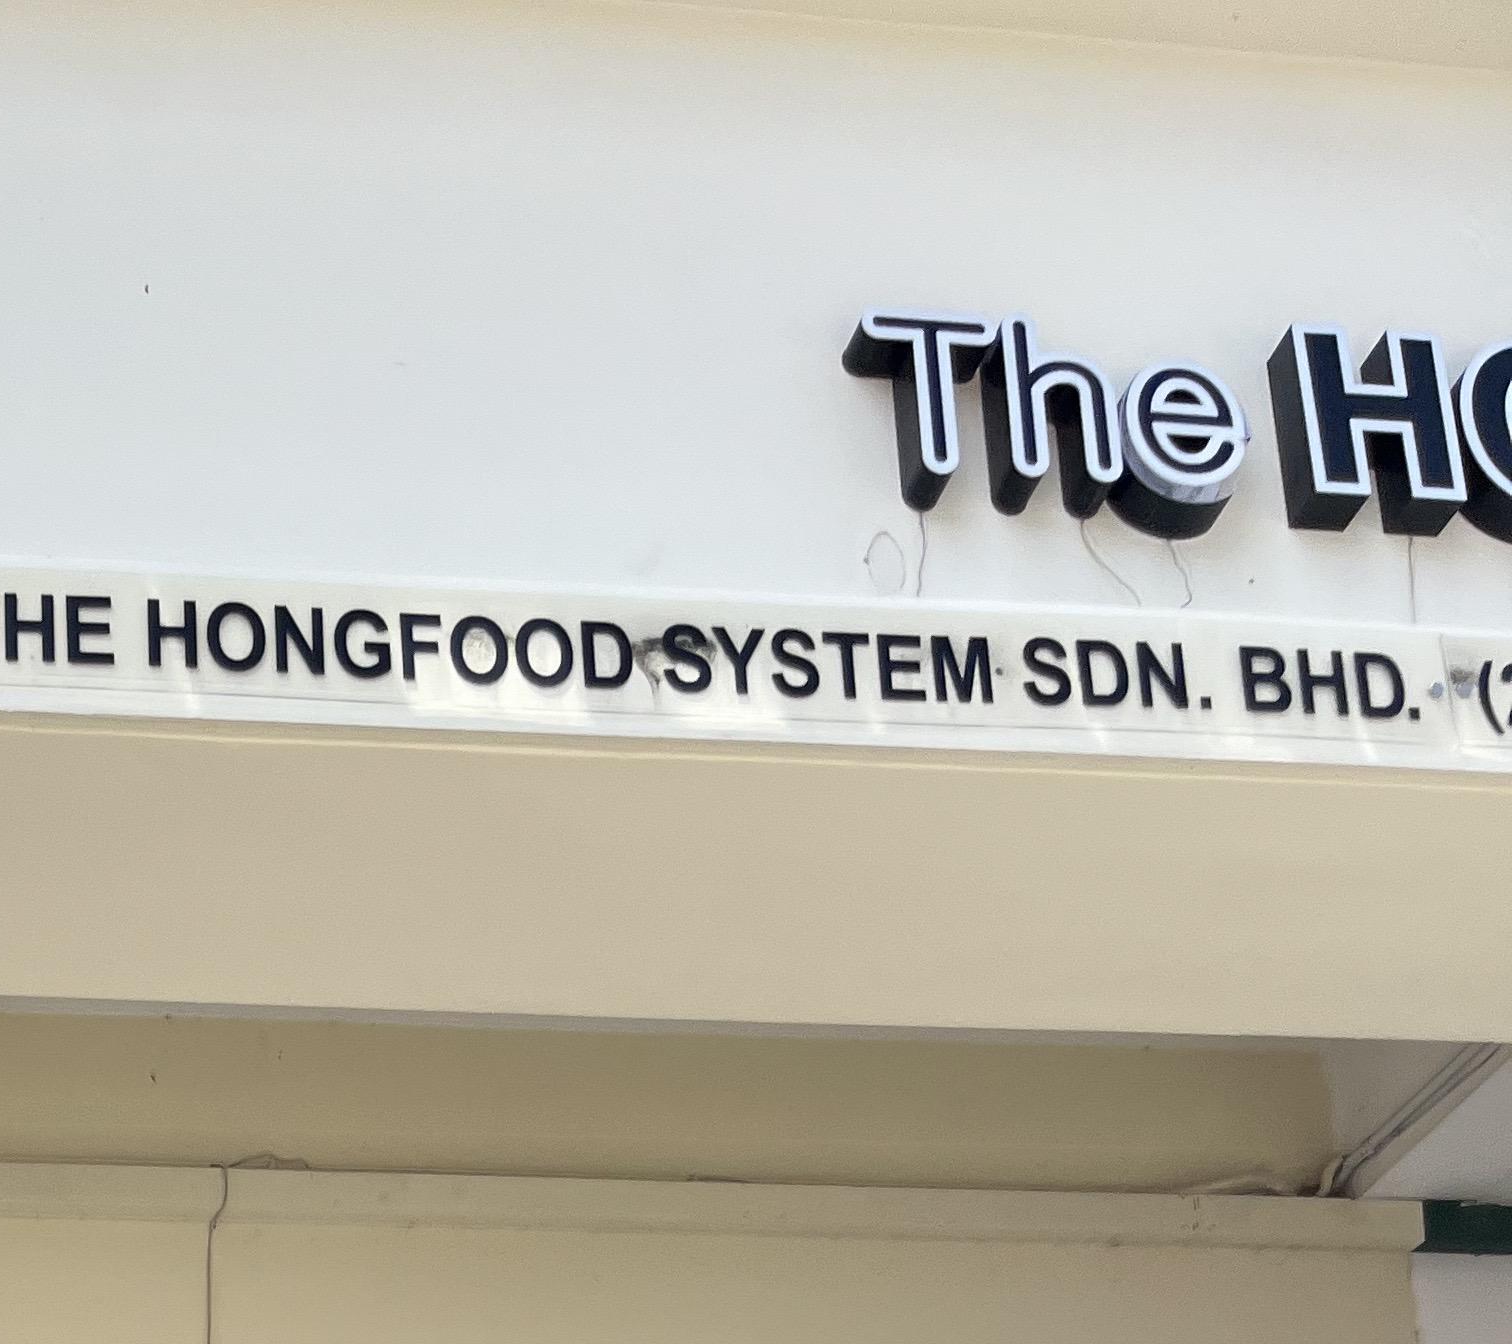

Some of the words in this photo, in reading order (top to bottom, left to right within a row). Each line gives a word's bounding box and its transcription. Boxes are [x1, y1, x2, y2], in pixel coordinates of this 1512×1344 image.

[846, 312, 1250, 525] The
[148, 597, 634, 689] HONGFOOD
[663, 623, 995, 705] SYSTEM
[1022, 637, 1213, 710] SDN.
[1238, 644, 1421, 722] BHD.
